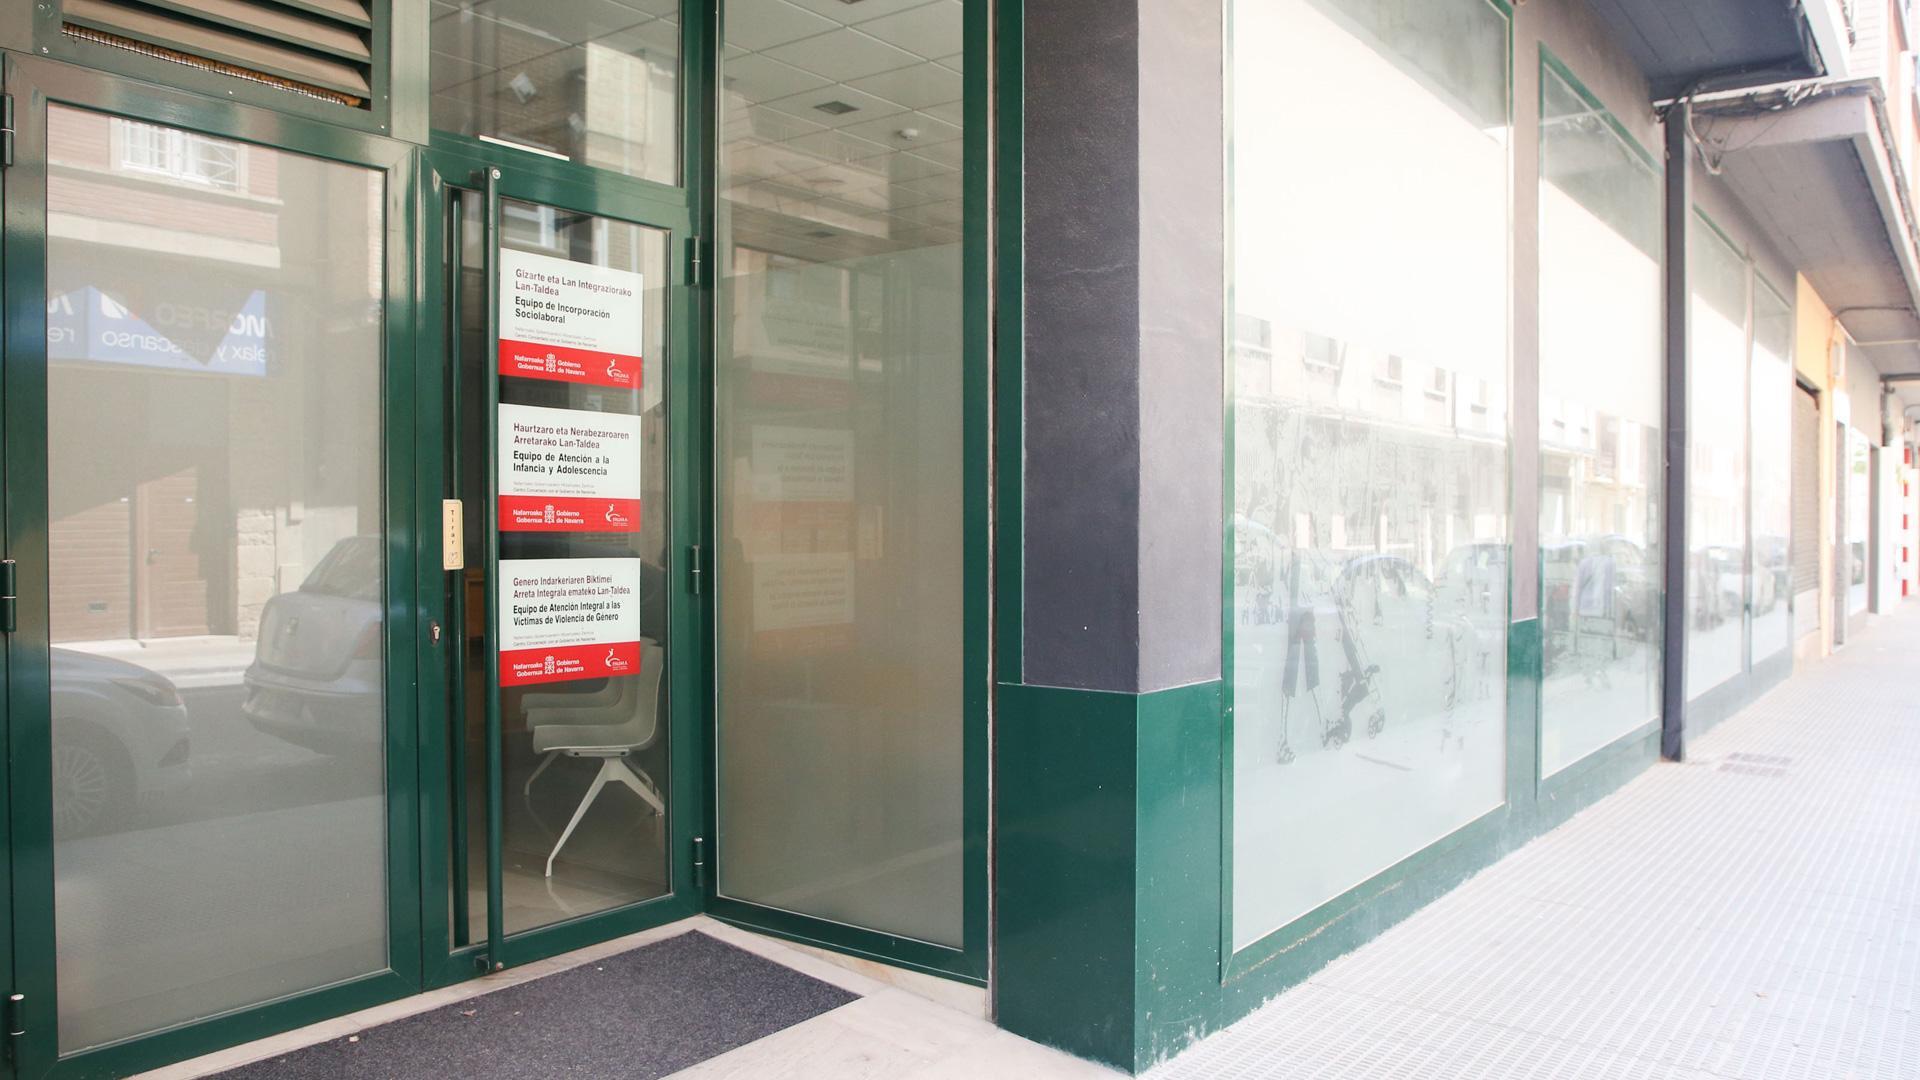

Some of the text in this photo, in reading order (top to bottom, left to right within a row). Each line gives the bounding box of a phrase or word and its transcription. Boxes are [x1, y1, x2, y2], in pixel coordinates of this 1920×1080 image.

[515, 281, 559, 296] Lan-Taldea
[516, 268, 632, 297] Gizarte eta Lan Integraziorako
[515, 296, 544, 310] Equipo
[545, 301, 556, 310] de
[515, 308, 566, 324] Sociolaboral
[514, 355, 544, 364] Nafarroako
[517, 362, 544, 371] Gobernua
[557, 360, 581, 368] Gobierno
[513, 423, 629, 440] Haurtzaro eta Nerabezaroaren
[514, 435, 600, 449] Arretarako Lan-Taldea
[513, 450, 542, 462] Equipo
[545, 452, 555, 461] de
[603, 456, 610, 464] la
[513, 463, 608, 475] Infancia y Adolescencia
[513, 575, 612, 586] Genero Indarkeriaren Biktimei
[514, 586, 630, 599] Arreta Integrala emateko Lan-Taldea
[513, 604, 537, 615] Equipo
[539, 604, 548, 613] de
[549, 602, 579, 612] Atención
[580, 601, 604, 612] Integral
[611, 601, 620, 609] las
[545, 616, 553, 625] de
[555, 614, 585, 623] Violencia
[586, 614, 594, 622] de
